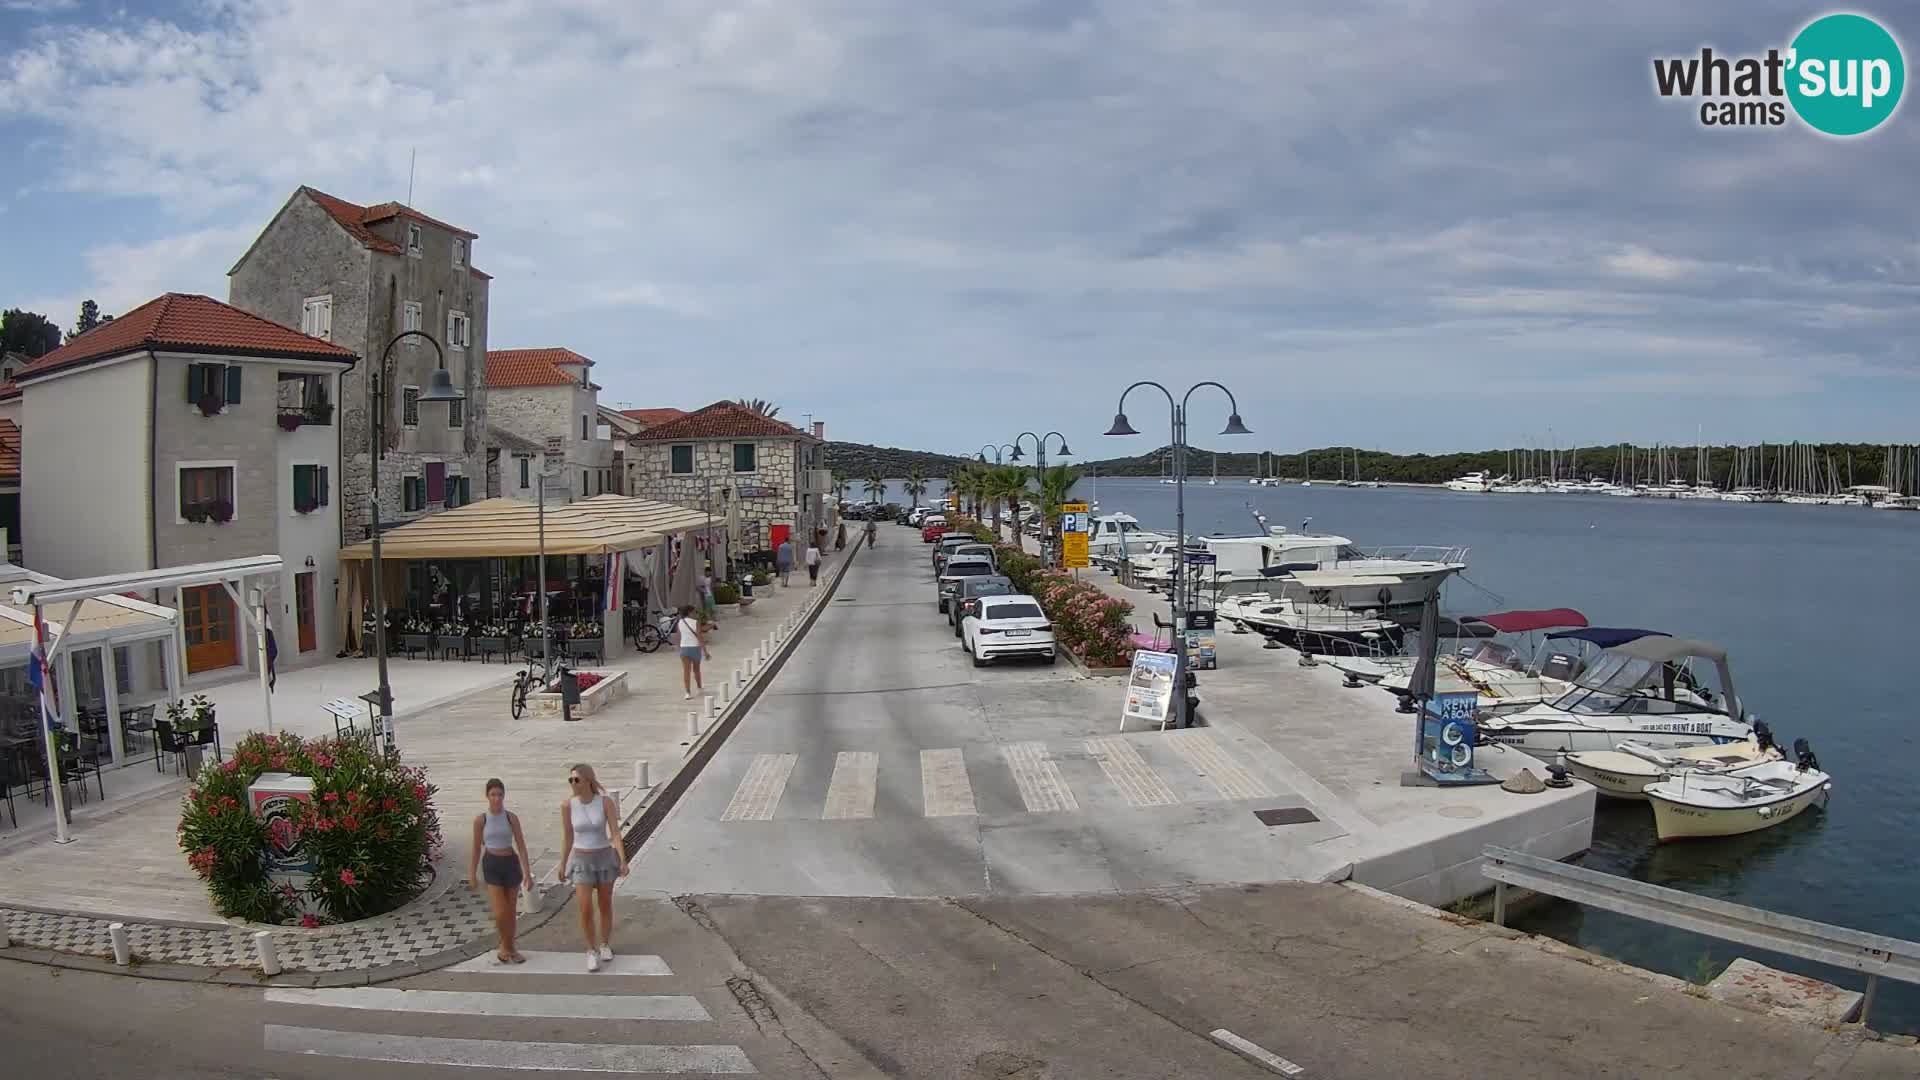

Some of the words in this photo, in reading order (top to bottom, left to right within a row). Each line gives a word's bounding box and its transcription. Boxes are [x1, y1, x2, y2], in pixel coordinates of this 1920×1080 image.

[1443, 698, 1476, 710] RENT
[1451, 710, 1473, 719] BOAT
[1672, 723, 1690, 733] RENT
[1696, 722, 1712, 734] BOAT
